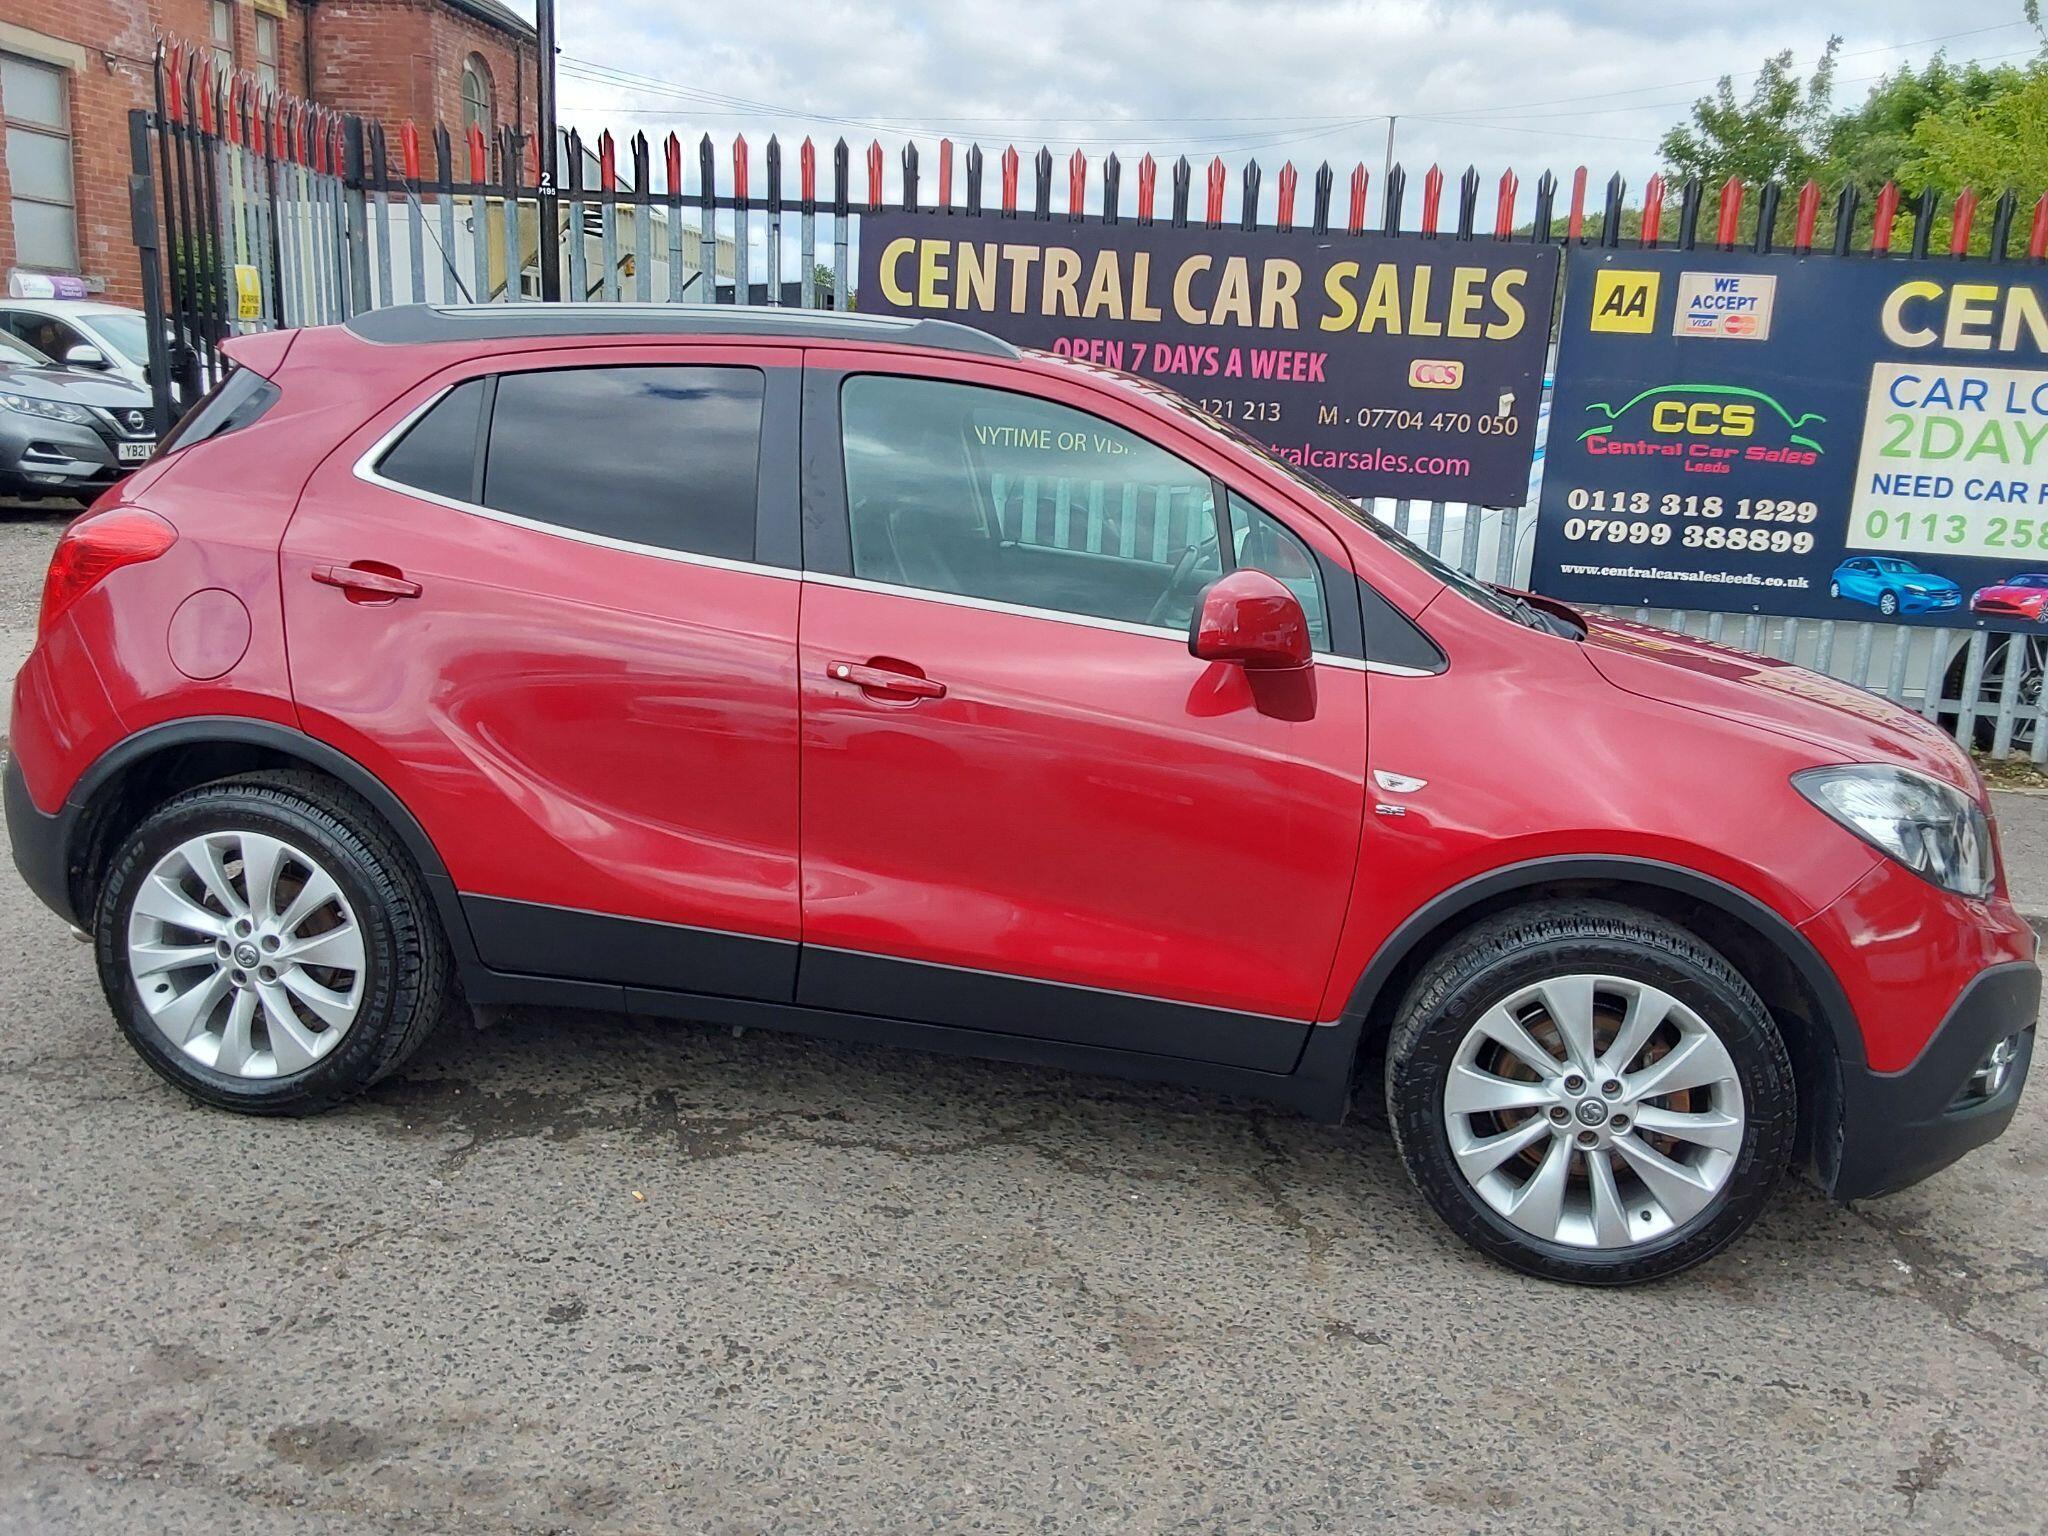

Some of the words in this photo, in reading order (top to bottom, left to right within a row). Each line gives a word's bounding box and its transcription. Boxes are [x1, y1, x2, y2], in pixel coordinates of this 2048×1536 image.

[541, 172, 551, 187] 2
[879, 237, 1162, 323] CENTRAL
[1173, 254, 1302, 330] CAR
[1319, 261, 1528, 340] SALES
[1599, 285, 1648, 317] AA
[1714, 278, 1740, 293] WE
[1690, 295, 1758, 311] ACCEPT
[1882, 281, 2048, 353] CEN
[1692, 319, 1713, 328] VISA
[1053, 337, 1124, 370] OPEN
[1131, 343, 1147, 371] 7
[1153, 343, 1219, 376] DAYS
[1224, 348, 1243, 377] A
[1250, 349, 1327, 383] WEEK
[1415, 364, 1457, 385] CCS
[1889, 375, 1989, 412] CAR
[1242, 401, 1281, 422] 213
[1357, 408, 1424, 430] 07704
[1430, 413, 1471, 433] 470
[1478, 415, 1519, 436] 050
[1652, 401, 1755, 437] CCS
[1057, 432, 1087, 452] OR
[1093, 434, 1137, 456] VIS
[1586, 435, 1683, 457] Central
[1689, 444, 1739, 459] Car
[1745, 446, 1818, 466] Sales
[1684, 459, 1731, 474] Leeds
[1871, 473, 1954, 499] NEED
[1964, 479, 2029, 504] CAR
[1568, 488, 1651, 514] 0113
[1660, 494, 1724, 518] 318
[1735, 499, 1818, 524] 1229
[1564, 518, 1672, 546] 07999
[1682, 525, 1815, 554] 388899
[1865, 509, 1968, 544] 0113
[1560, 564, 1809, 589] www.centralcarsalesleeds.co.uk
